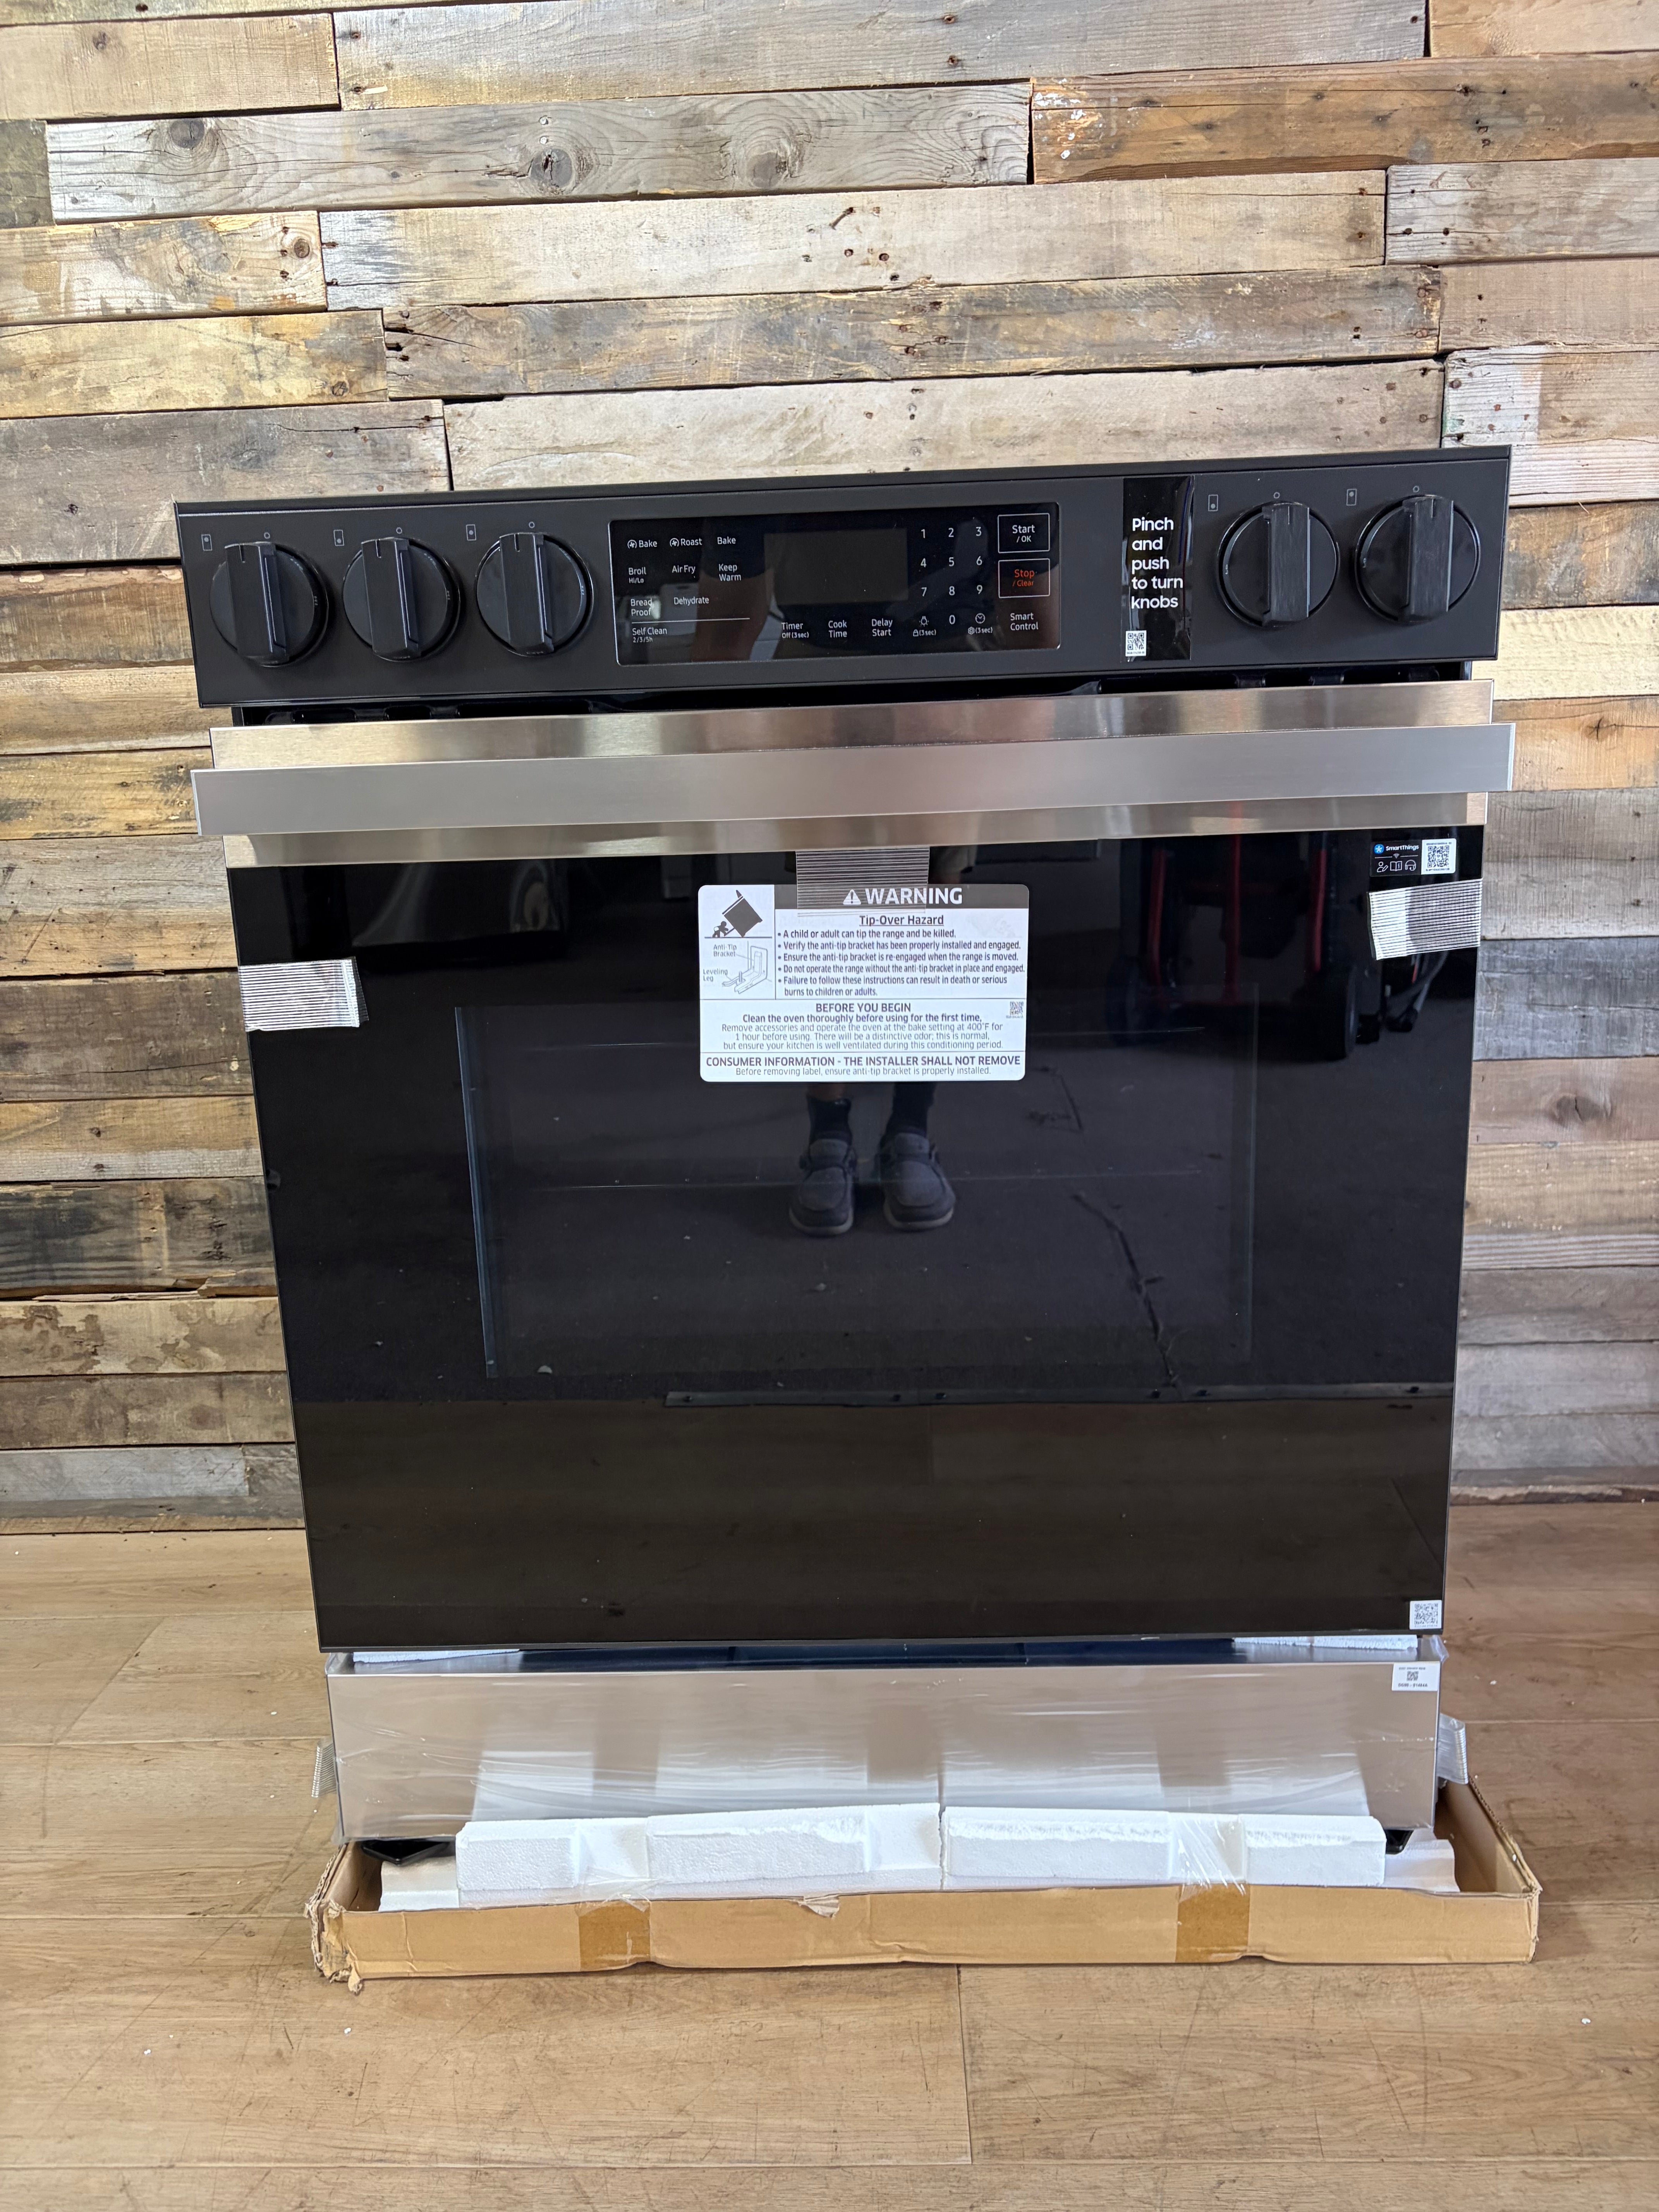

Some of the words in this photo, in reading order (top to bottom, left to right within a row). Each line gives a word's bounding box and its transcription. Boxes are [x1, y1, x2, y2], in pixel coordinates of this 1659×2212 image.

[1132, 517, 1174, 531] Pinch
[921, 529, 925, 538] 1
[948, 528, 954, 537] 2
[976, 527, 982, 536] 3
[1012, 525, 1035, 534] Start
[717, 536, 736, 544] Bake
[1132, 537, 1163, 551] and
[921, 558, 927, 568] 4
[949, 557, 954, 567] 5
[976, 556, 982, 565] 6
[684, 565, 696, 574] Fry
[719, 563, 737, 572] Keep
[1132, 556, 1169, 575] push
[629, 567, 646, 575] Broil
[1014, 569, 1035, 579] Stop
[719, 574, 741, 582] Warm
[1131, 576, 1148, 589] to
[1151, 576, 1183, 589] turn
[921, 587, 927, 597] 7
[949, 586, 955, 596] 8
[977, 585, 982, 594] 9
[630, 598, 652, 606] Bread
[674, 596, 709, 606] Dehydrate
[1131, 595, 1178, 609] knobs
[631, 608, 651, 616] Proof
[828, 620, 847, 628] Cook
[871, 618, 893, 627] Delay
[949, 615, 955, 624] 0
[632, 627, 646, 635] Self
[647, 627, 667, 635] Clean
[1010, 622, 1039, 631] Control
[865, 888, 963, 905] WARNING
[859, 915, 905, 926] Tip-Over
[907, 915, 944, 925] Hazard
[783, 929, 789, 938] A
[791, 929, 808, 938] child
[821, 929, 840, 938] adult
[856, 929, 866, 939] tip
[868, 929, 881, 938] the
[883, 931, 904, 939] range
[906, 929, 920, 938] and
[922, 929, 931, 937] be
[933, 929, 956, 937] killed.
[783, 941, 805, 951] Verify
[807, 941, 819, 950] the
[820, 941, 846, 950] anti-tip
[848, 941, 875, 949] bracket
[876, 941, 888, 949] has
[890, 941, 907, 949] been
[909, 941, 940, 951] properly
[942, 940, 972, 949] installed
[974, 941, 987, 949] and
[988, 941, 1021, 950] engaged.
[783, 953, 807, 961] Ensure
[809, 953, 821, 961] the
[823, 953, 848, 962] anti-tip
[850, 952, 877, 961] bracket
[886, 952, 926, 963] re-engaged
[928, 952, 947, 961] when
[949, 952, 961, 960] the
[962, 953, 983, 962] range
[984, 952, 990, 960] is
[992, 952, 1018, 960] moved.
[703, 968, 728, 977] Leveling
[783, 964, 793, 973] Do
[794, 965, 805, 973] not
[806, 965, 831, 974] operate
[833, 964, 843, 972] the
[845, 965, 864, 974] range
[865, 964, 891, 972] without
[892, 964, 903, 972] the
[904, 964, 928, 974] anti-tip
[929, 963, 954, 972] bracket
[963, 963, 980, 974] place
[981, 963, 994, 972] and
[995, 964, 1025, 974] engaged.
[784, 975, 808, 984] Failure
[819, 975, 841, 984] follow
[843, 976, 862, 984] these
[864, 976, 904, 984] instructions
[920, 975, 940, 984] result
[942, 975, 948, 984] in
[950, 975, 970, 984] death
[982, 975, 1007, 984] serious
[785, 988, 804, 996] burns
[815, 987, 843, 996] children
[854, 987, 878, 996] adults.
[816, 1003, 854, 1013] BEFORE
[858, 1003, 878, 1012] YOU
[882, 1003, 910, 1012] BEGIN
[743, 1014, 765, 1022] Clean
[768, 1014, 781, 1022] the
[807, 1014, 854, 1024] thoroughly
[856, 1013, 883, 1022] before
[886, 1014, 908, 1023] using
[911, 1013, 923, 1022] for
[926, 1013, 939, 1022] the
[941, 1013, 958, 1021] first
[706, 1057, 761, 1066] CONSUMER
[765, 1056, 834, 1066] INFORMATION
[844, 1056, 862, 1066] THE
[866, 1056, 918, 1066] INSTALLER
[921, 1056, 952, 1065] SHALL
[955, 1056, 975, 1065] NOT
[979, 1055, 1020, 1065] REMOVE
[764, 1068, 800, 1077] removing
[883, 1066, 911, 1075] bracket
[922, 1066, 955, 1076] properly
